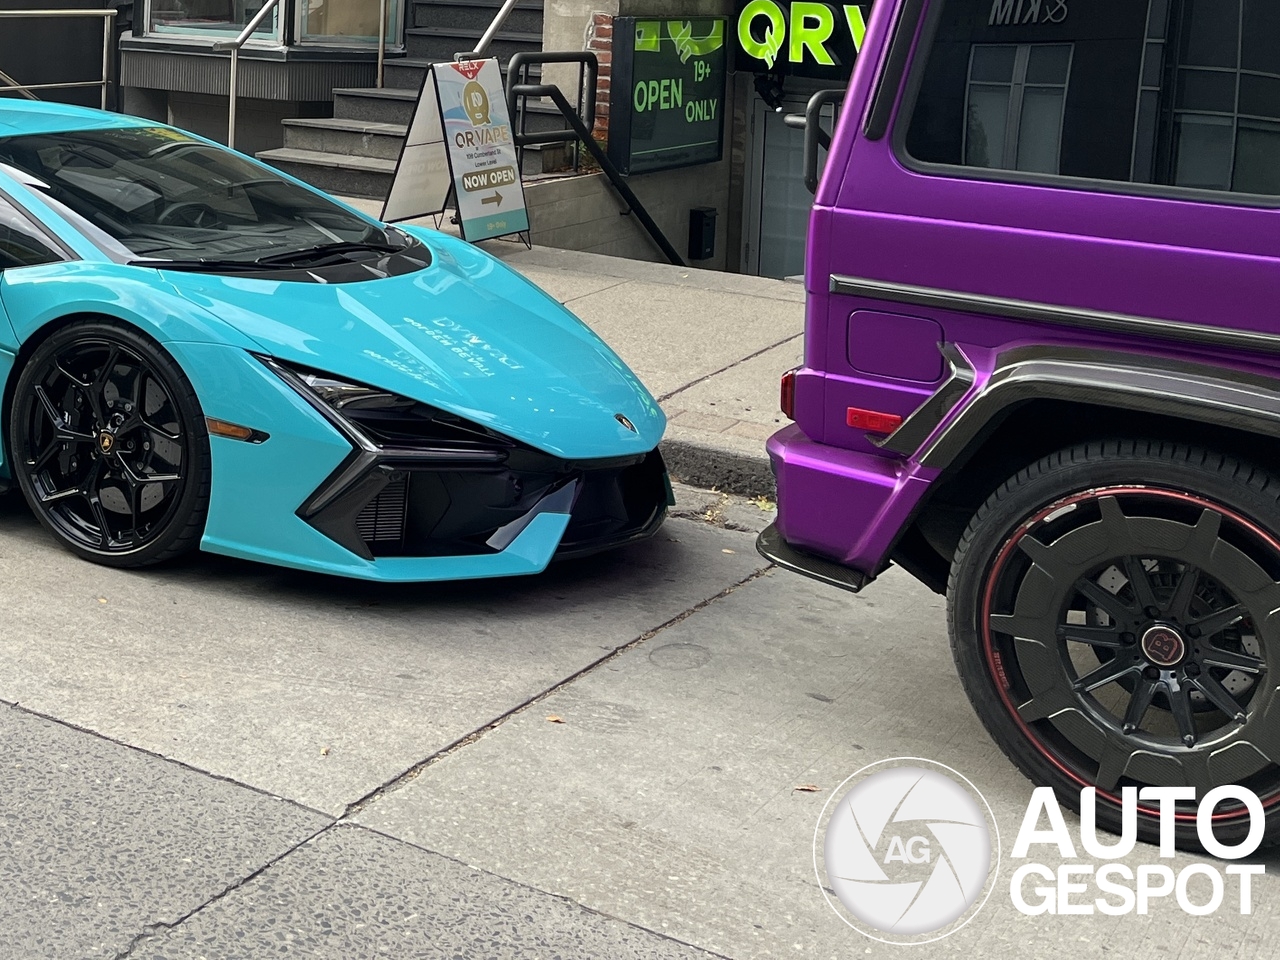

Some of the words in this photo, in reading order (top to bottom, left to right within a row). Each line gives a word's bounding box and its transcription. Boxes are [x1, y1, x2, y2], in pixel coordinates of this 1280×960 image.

[458, 62, 479, 72] RELX
[693, 60, 711, 83] 19+
[633, 78, 683, 113] OPEN
[685, 98, 717, 123] ONLY
[474, 150, 496, 160] Cumberland
[475, 160, 487, 168] Lower
[463, 175, 488, 189] NOW
[489, 169, 515, 184] OPEN
